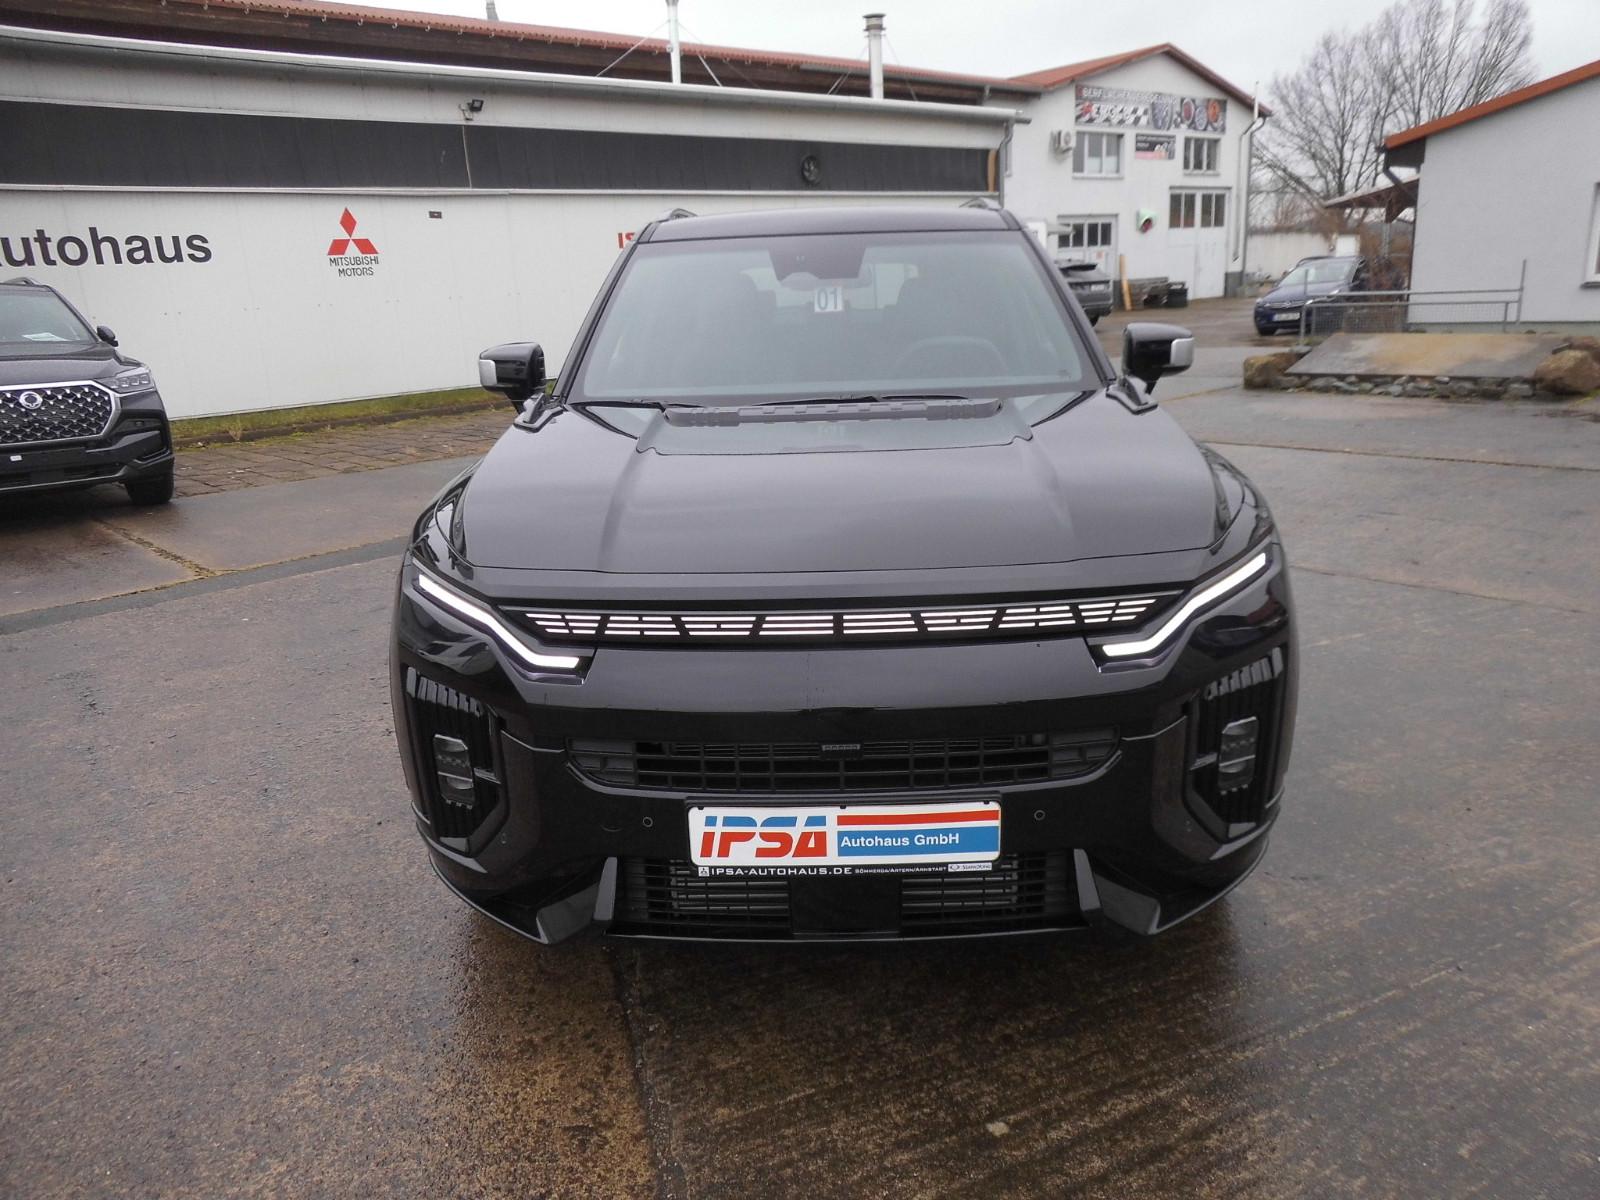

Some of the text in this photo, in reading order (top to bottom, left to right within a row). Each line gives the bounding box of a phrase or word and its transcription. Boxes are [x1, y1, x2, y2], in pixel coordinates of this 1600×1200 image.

[0, 226, 212, 267] utohaus
[329, 256, 380, 267] MITSUBISHI
[338, 266, 374, 277] MOTORS
[817, 287, 838, 311] 01
[700, 816, 827, 858] IPSA
[841, 832, 960, 848] Autohaus GmbH
[711, 867, 852, 876] IPSA-AUTOHAUS.DE
